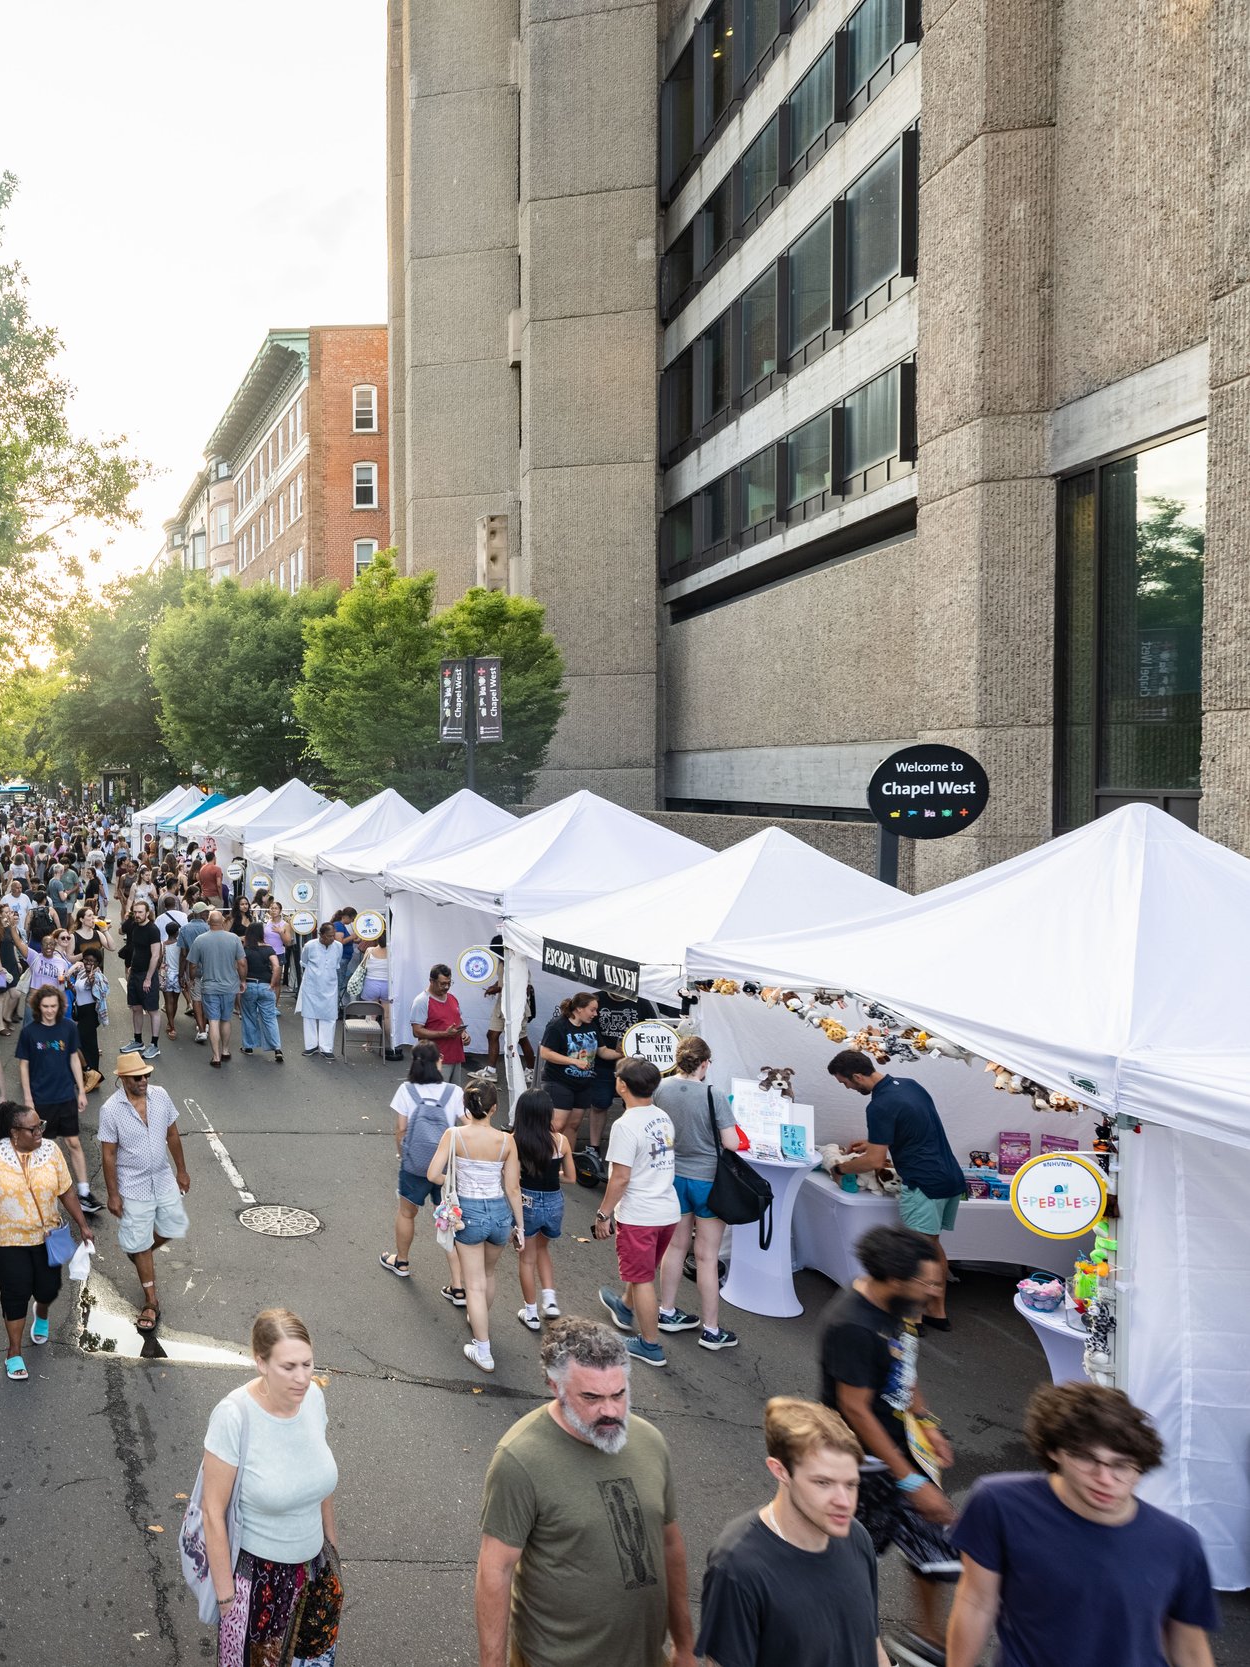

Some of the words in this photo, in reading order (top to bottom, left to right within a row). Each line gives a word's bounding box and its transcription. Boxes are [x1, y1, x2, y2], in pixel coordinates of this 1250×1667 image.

[455, 691, 463, 718] Chapel
[490, 689, 499, 717] Chapel
[896, 762, 948, 772] Welcome
[951, 762, 964, 772] to
[881, 781, 934, 798] Chapel
[937, 781, 976, 794] West
[544, 946, 576, 973] ESCAPE
[579, 956, 598, 980] NEW
[603, 964, 638, 992] HAVEN
[639, 1033, 673, 1044] ESCAPE
[654, 1044, 673, 1053] NEW
[646, 1054, 674, 1063] HAVEN
[1029, 1196, 1090, 1209] PEBBLES
